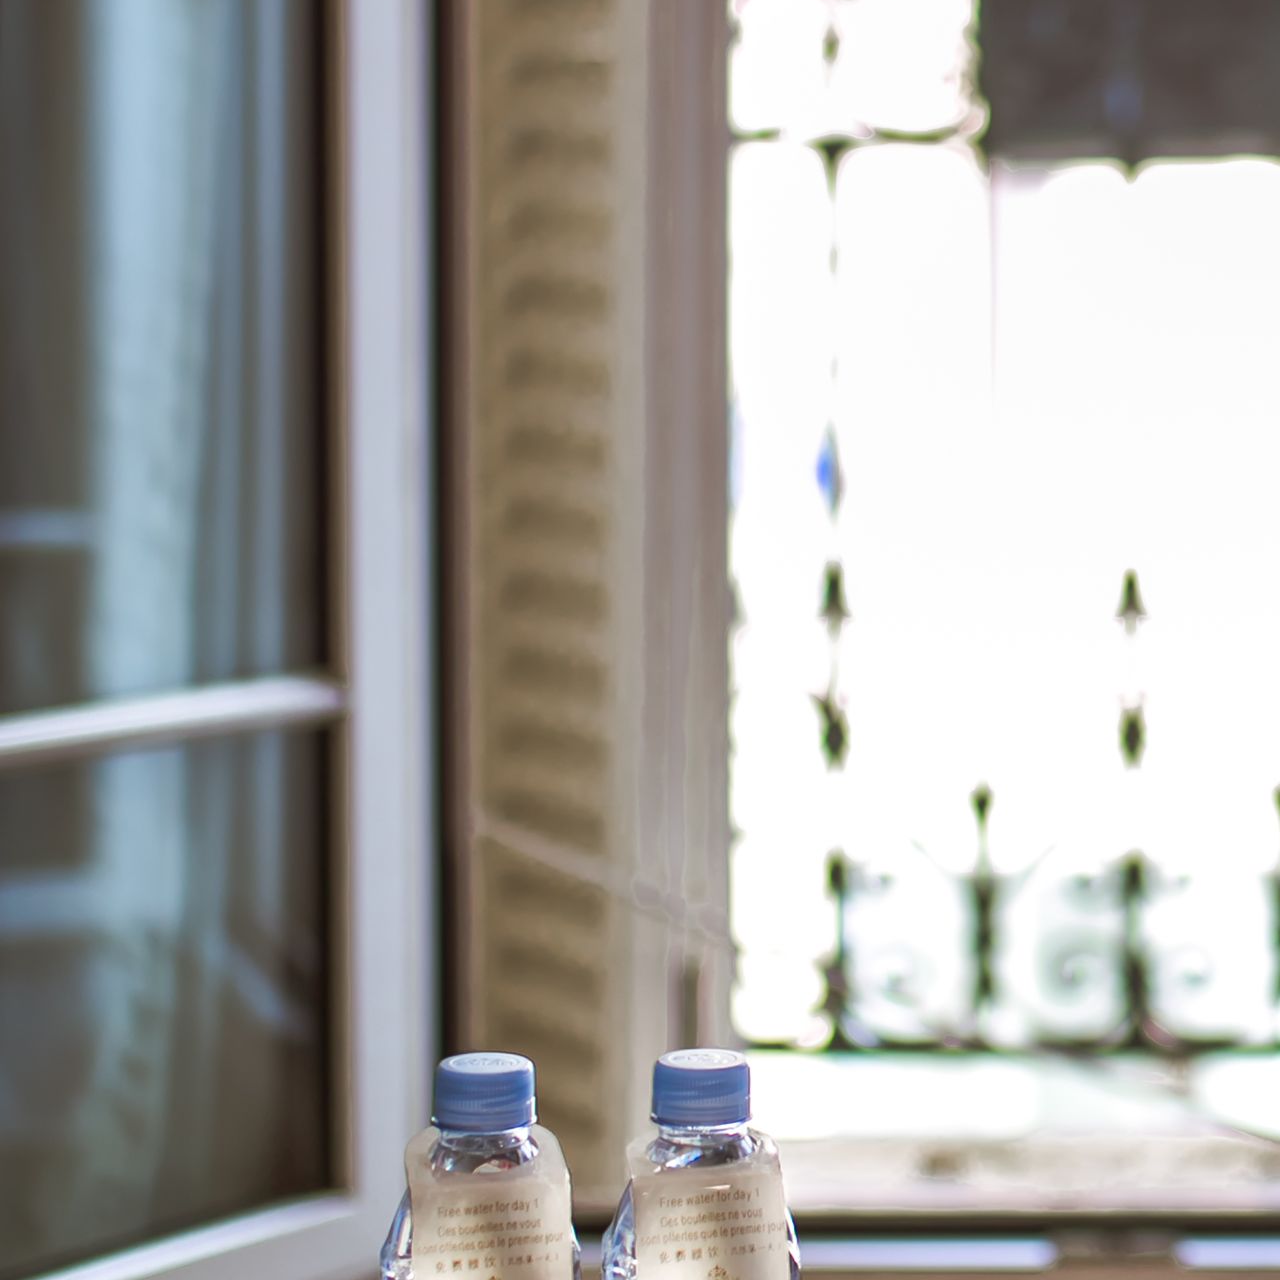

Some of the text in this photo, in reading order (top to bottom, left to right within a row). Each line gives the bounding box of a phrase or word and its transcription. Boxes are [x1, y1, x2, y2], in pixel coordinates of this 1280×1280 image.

[437, 1205, 461, 1217] Free
[464, 1202, 494, 1215] water
[495, 1200, 510, 1212] for
[511, 1198, 530, 1212] day
[659, 1196, 683, 1208] Free
[686, 1193, 715, 1205] water
[716, 1190, 731, 1202] for
[734, 1188, 752, 1202] day
[506, 1221, 517, 1231] ne
[520, 1218, 542, 1229] vous
[660, 1216, 679, 1228] Ces
[727, 1210, 740, 1221] ne
[742, 1207, 763, 1219] vous
[477, 1237, 495, 1250] que
[508, 1232, 543, 1248] premier
[700, 1228, 718, 1242] que
[719, 1226, 729, 1237] le
[731, 1223, 766, 1238] premier
